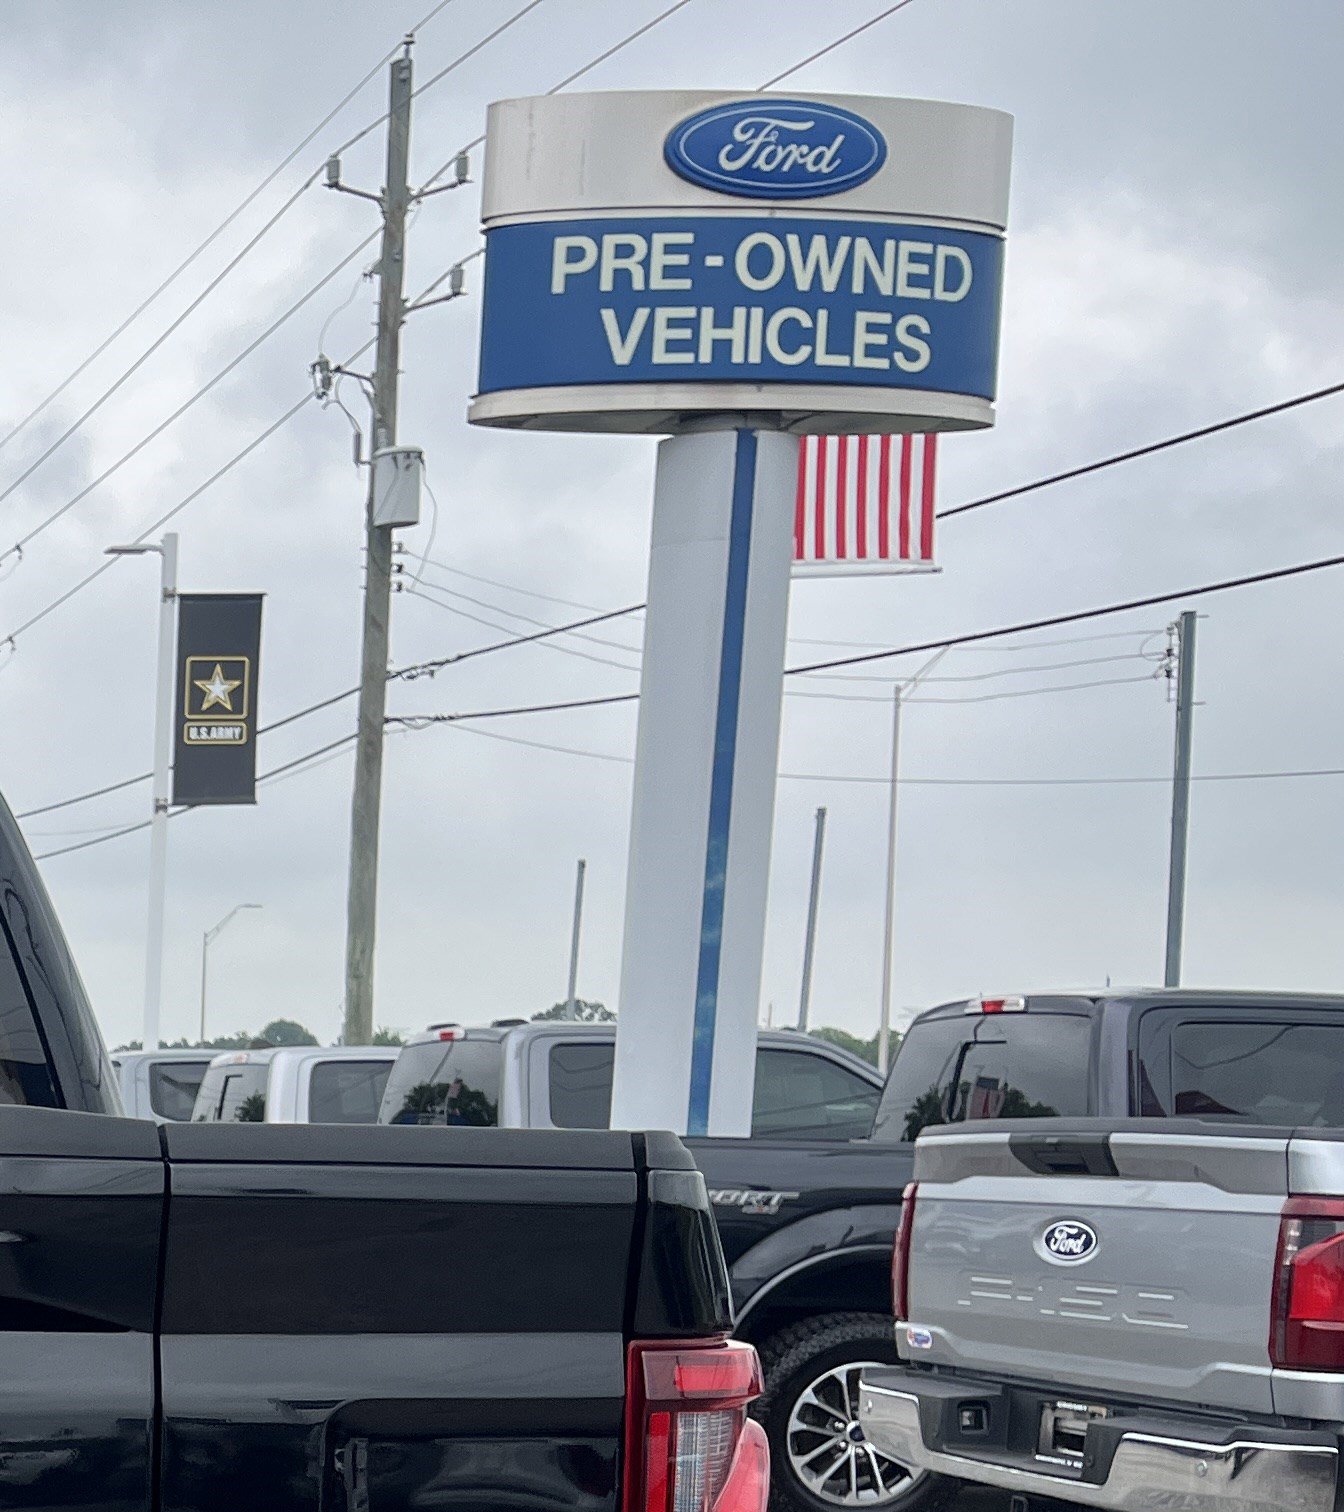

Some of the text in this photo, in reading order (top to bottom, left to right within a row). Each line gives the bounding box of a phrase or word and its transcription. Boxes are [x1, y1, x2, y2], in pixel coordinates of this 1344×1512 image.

[718, 116, 845, 175] Ford
[600, 305, 932, 374] VEHICLES
[1050, 1225, 1087, 1253] Ford
